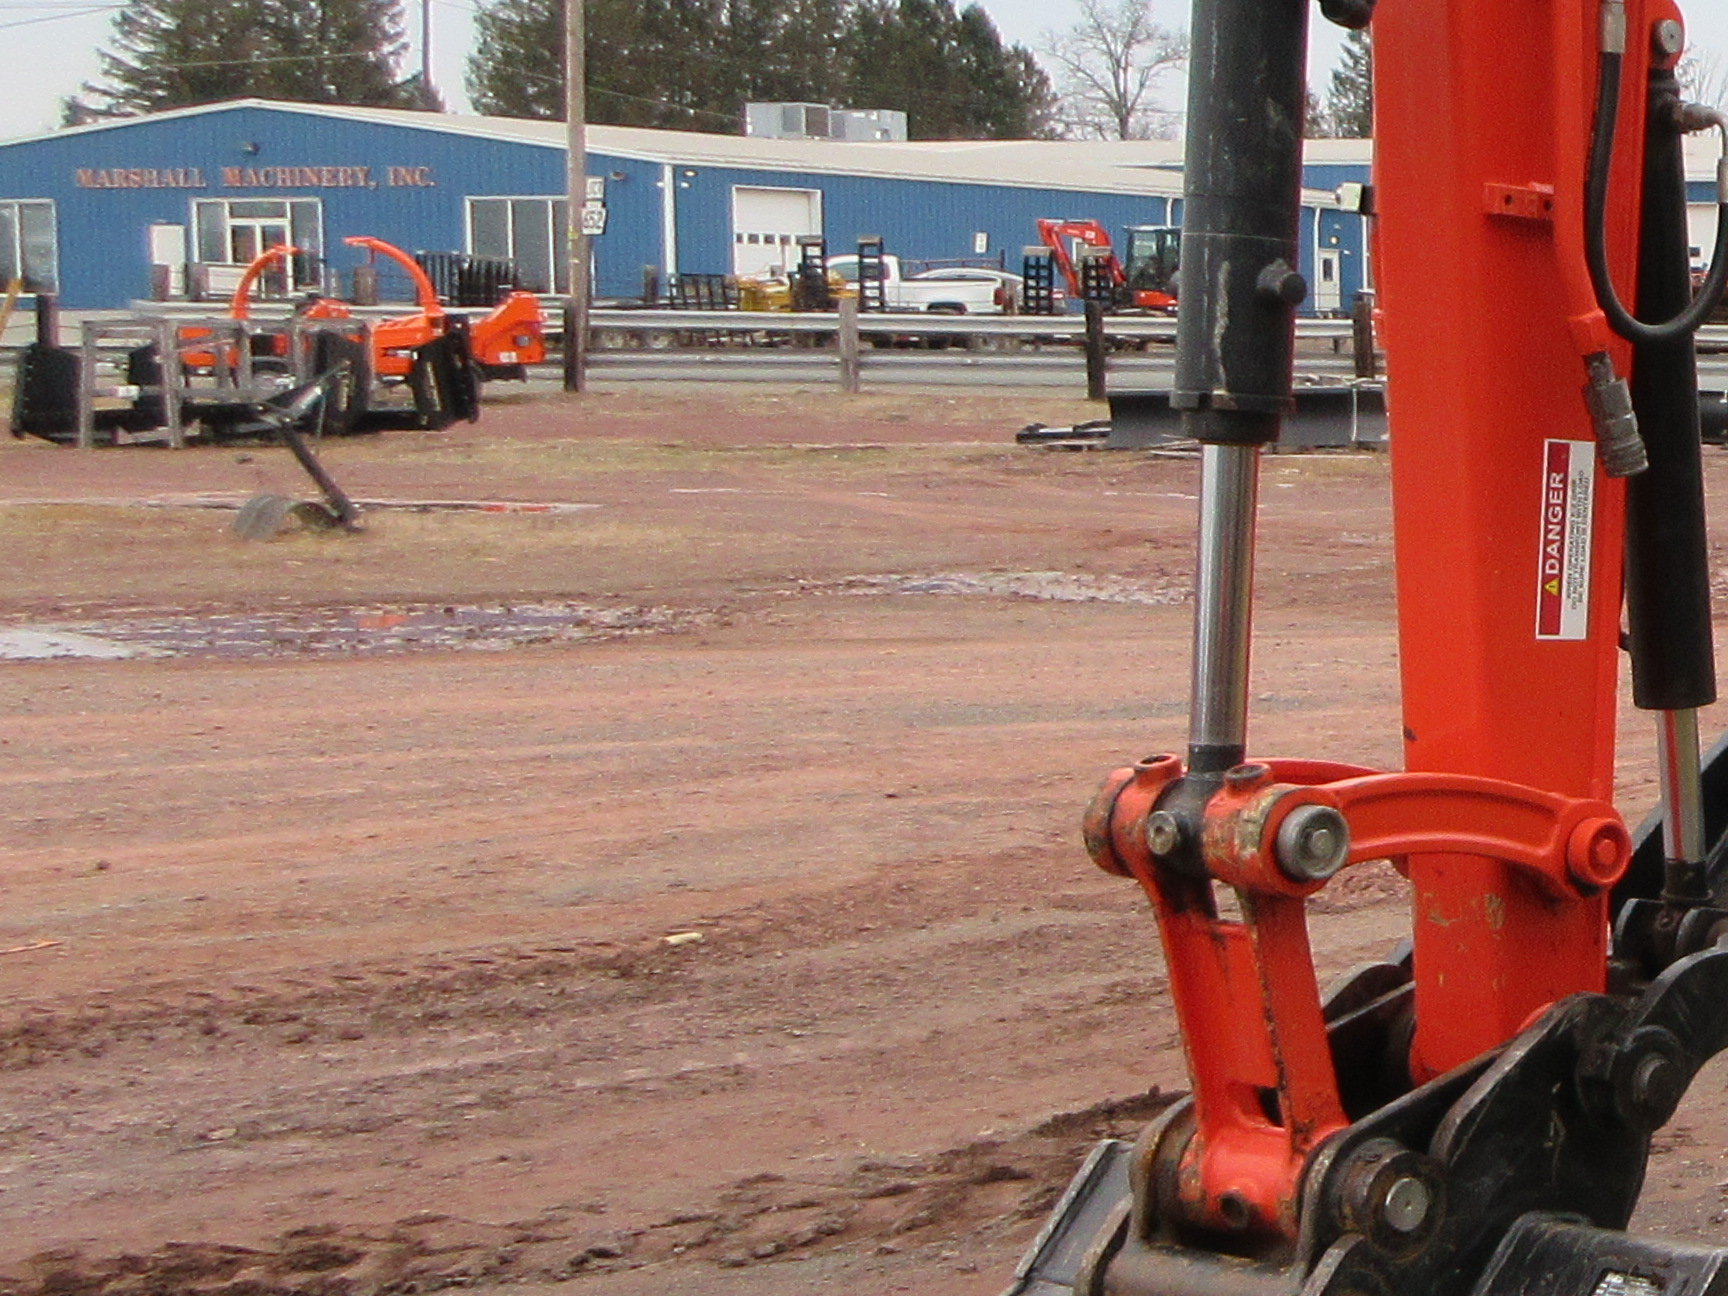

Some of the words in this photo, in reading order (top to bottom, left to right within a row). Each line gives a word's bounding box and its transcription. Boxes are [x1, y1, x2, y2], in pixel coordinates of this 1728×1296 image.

[75, 167, 207, 189] MARSHALL
[221, 166, 379, 191] MACHINERY,
[386, 166, 437, 188] INC.
[1545, 472, 1565, 575] DANGER
